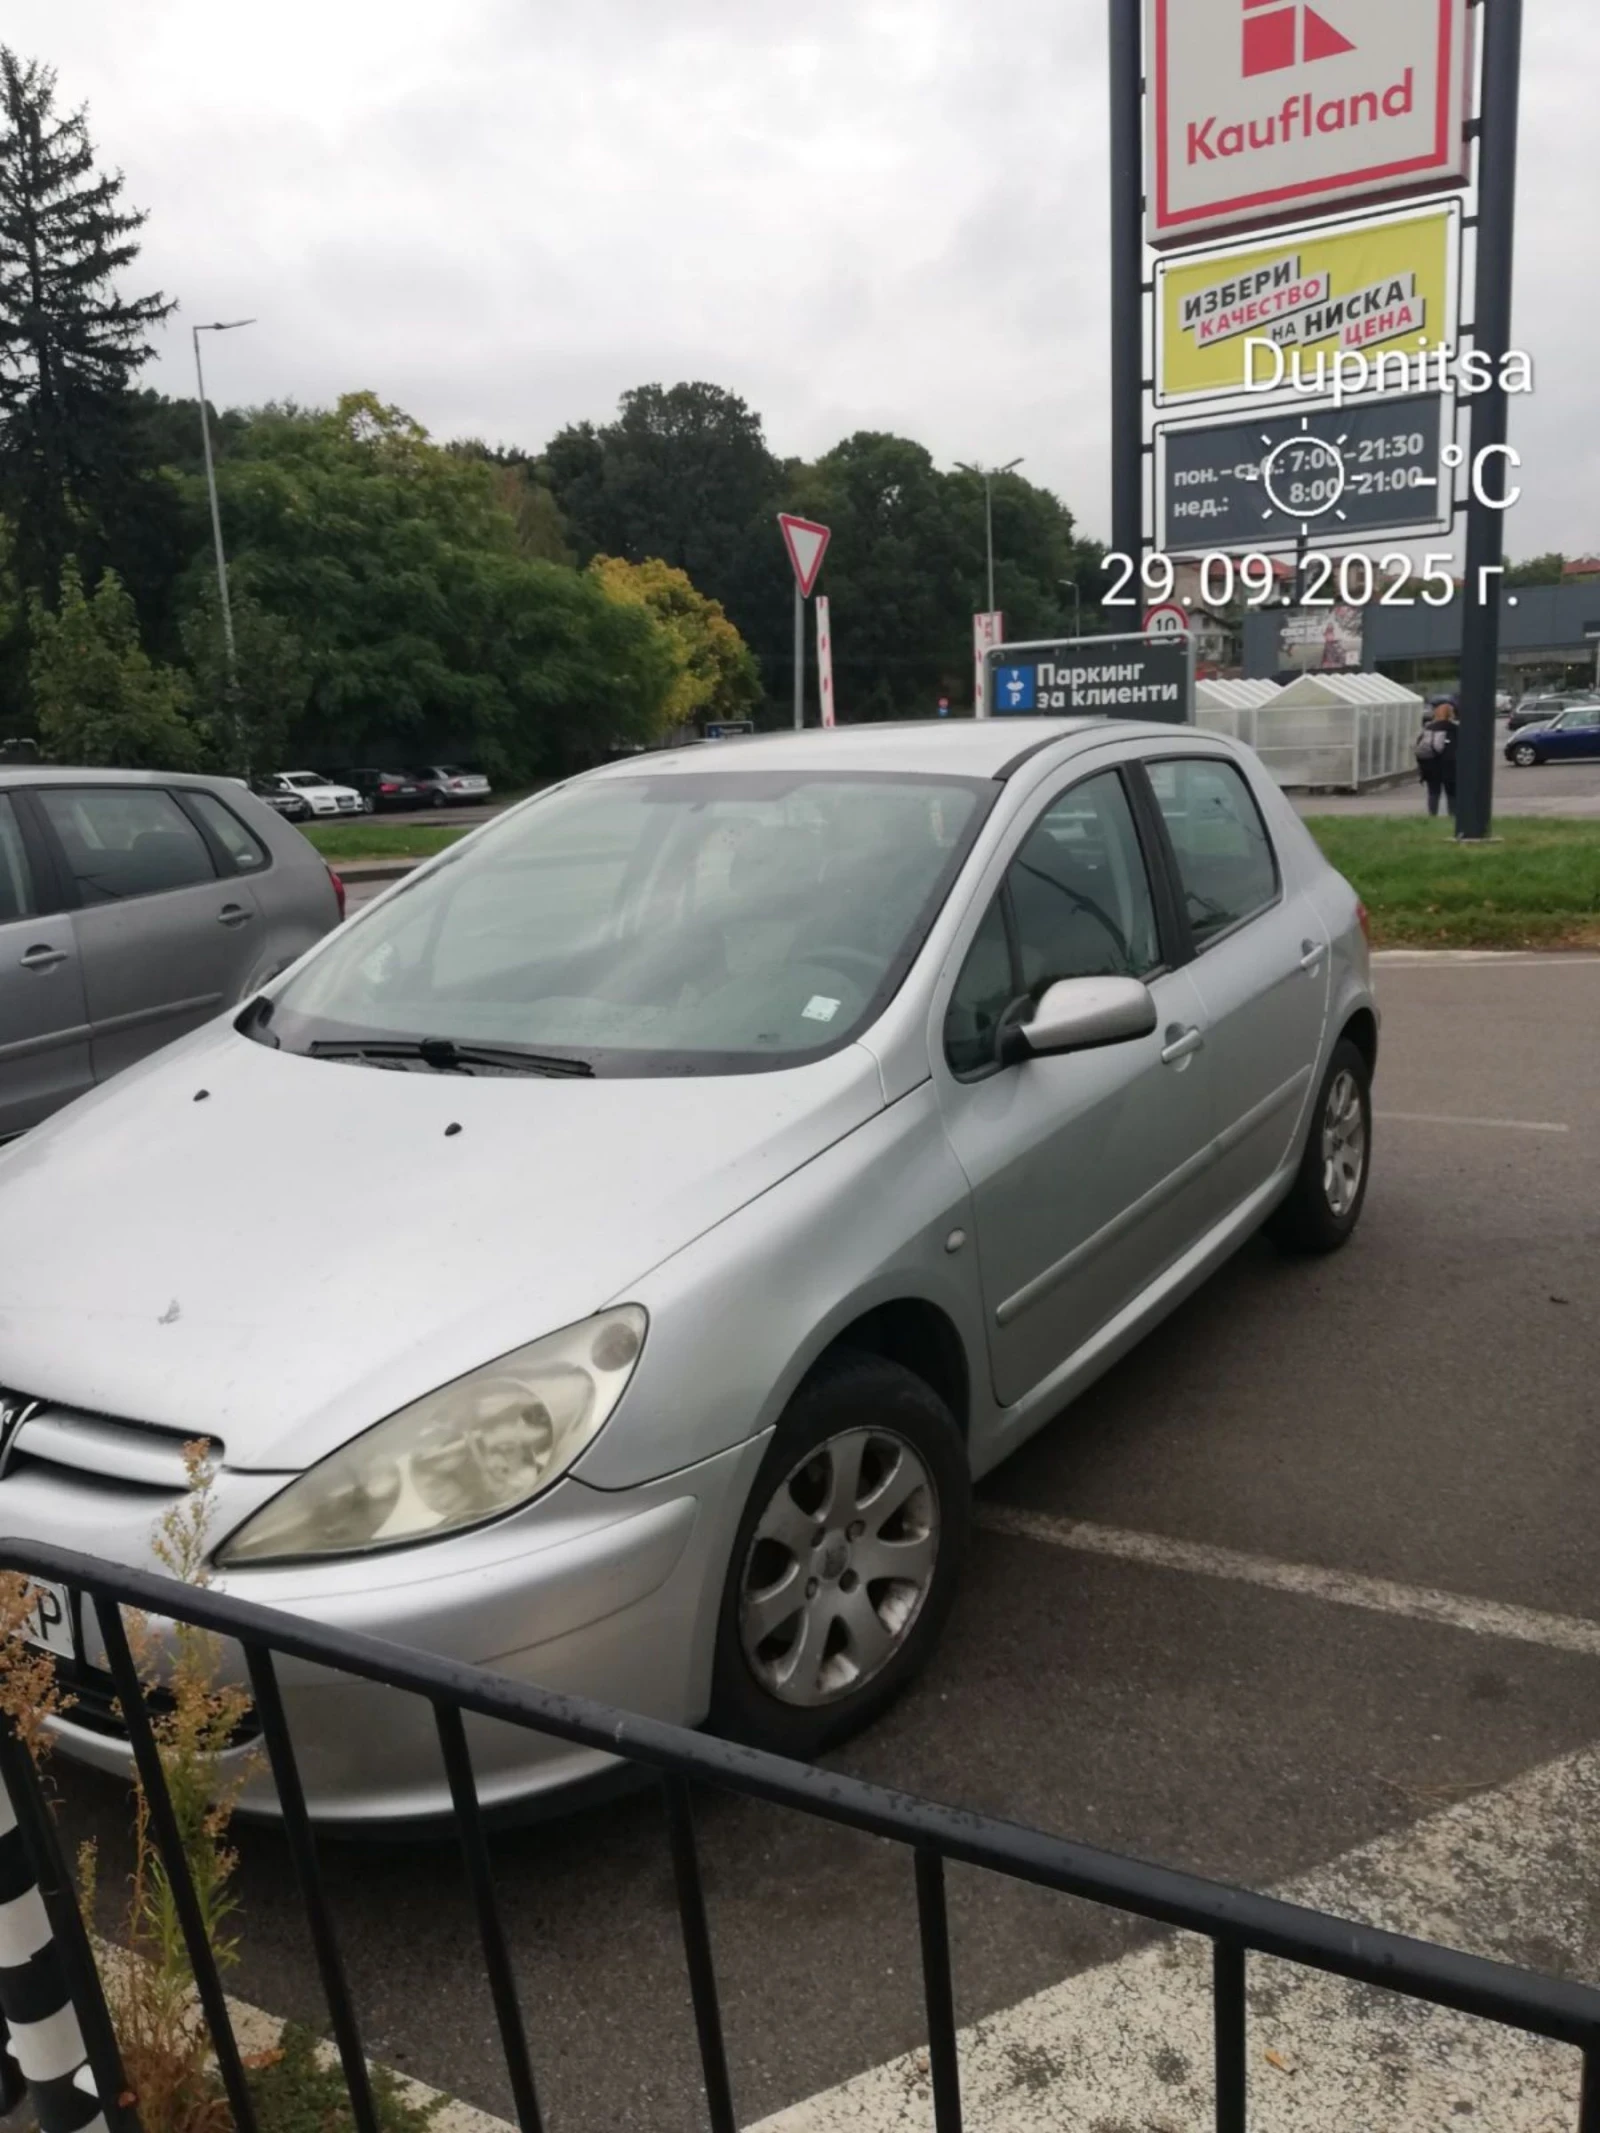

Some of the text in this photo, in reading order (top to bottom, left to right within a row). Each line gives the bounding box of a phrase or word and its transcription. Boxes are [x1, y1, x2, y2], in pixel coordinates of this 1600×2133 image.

[1187, 67, 1413, 165] Kaufland
[1184, 261, 1290, 322] ИЗБЕРИ
[1200, 279, 1320, 339] КАЧЕСТВО
[1272, 280, 1405, 342] НА НИСКА
[1345, 305, 1412, 346] ЦЕНА
[1174, 497, 1229, 517] нед.:
[1036, 663, 1145, 689] Паркинг
[1036, 684, 1178, 709] за клиенти
